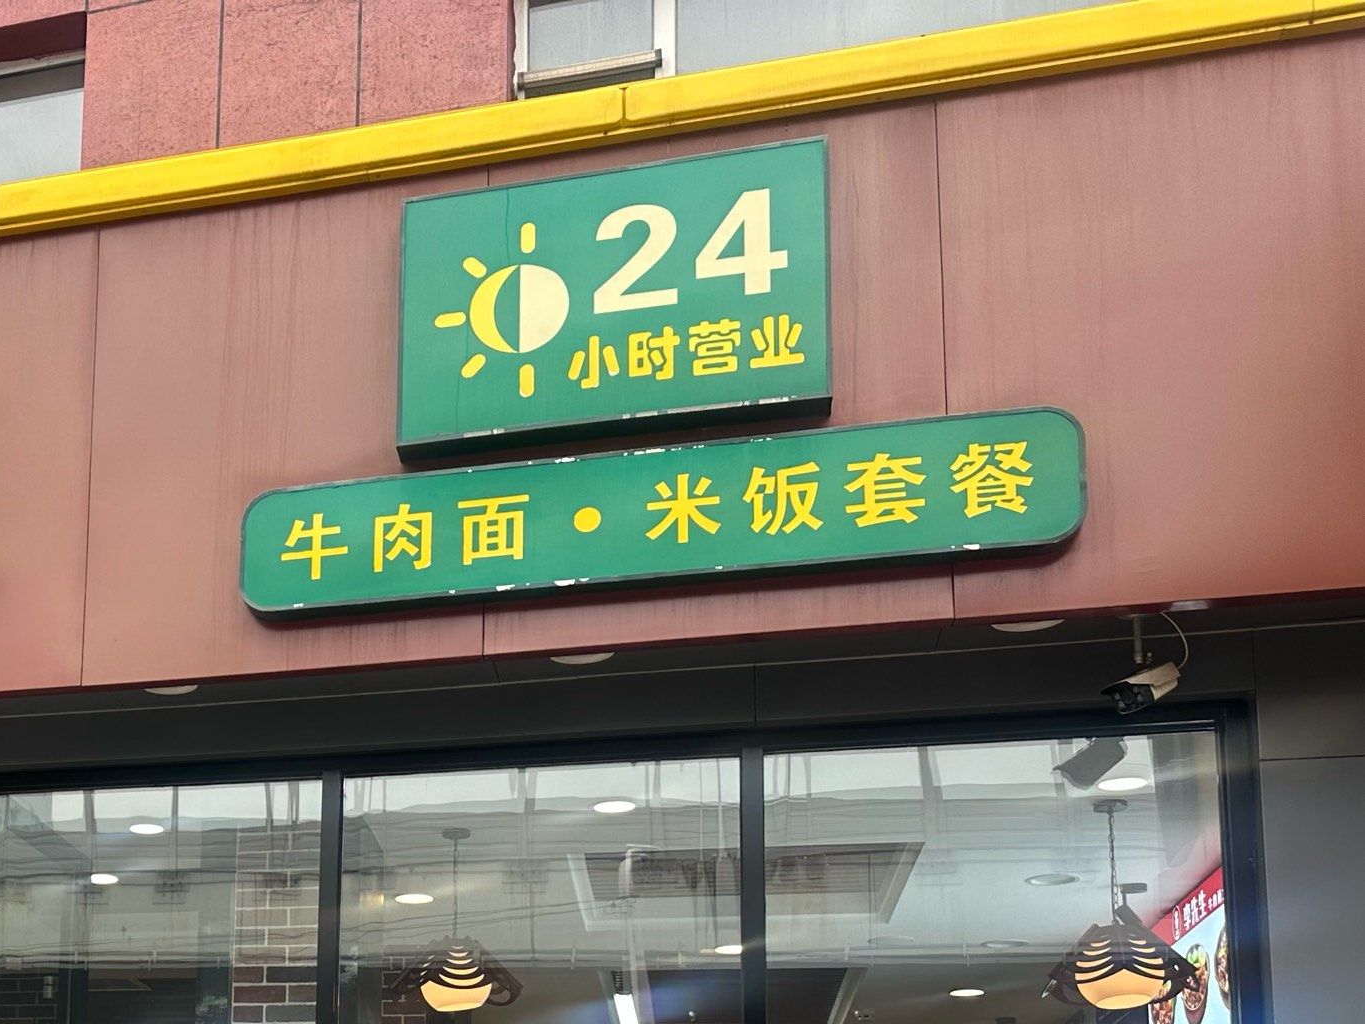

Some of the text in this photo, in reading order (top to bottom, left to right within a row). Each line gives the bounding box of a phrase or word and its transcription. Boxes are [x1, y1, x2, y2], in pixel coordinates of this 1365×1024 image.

[593, 188, 788, 314] 24
[567, 314, 805, 390] 小时营业
